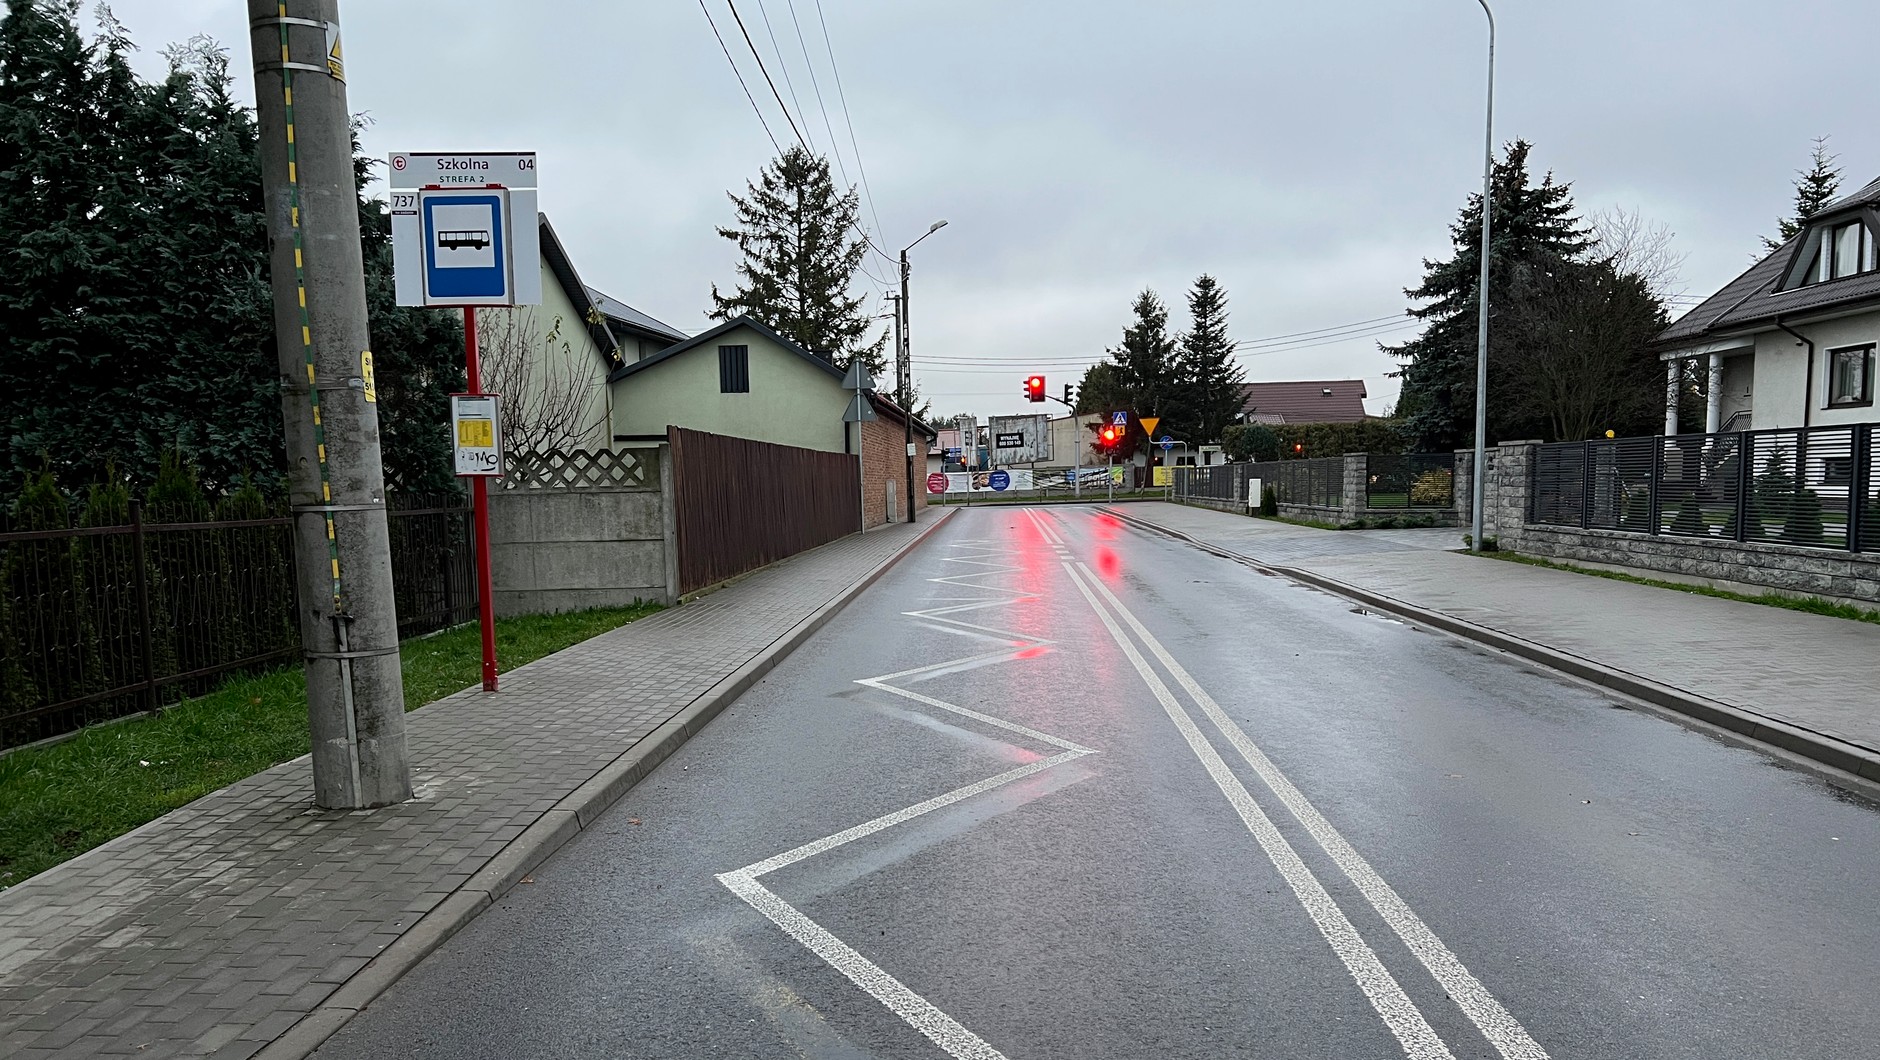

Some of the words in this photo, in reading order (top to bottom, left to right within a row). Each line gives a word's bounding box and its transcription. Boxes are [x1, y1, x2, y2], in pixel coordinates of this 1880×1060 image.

[437, 158, 489, 170] Szkolna
[518, 159, 534, 171] 04
[439, 175, 476, 183] STREFA
[393, 195, 414, 207] 737
